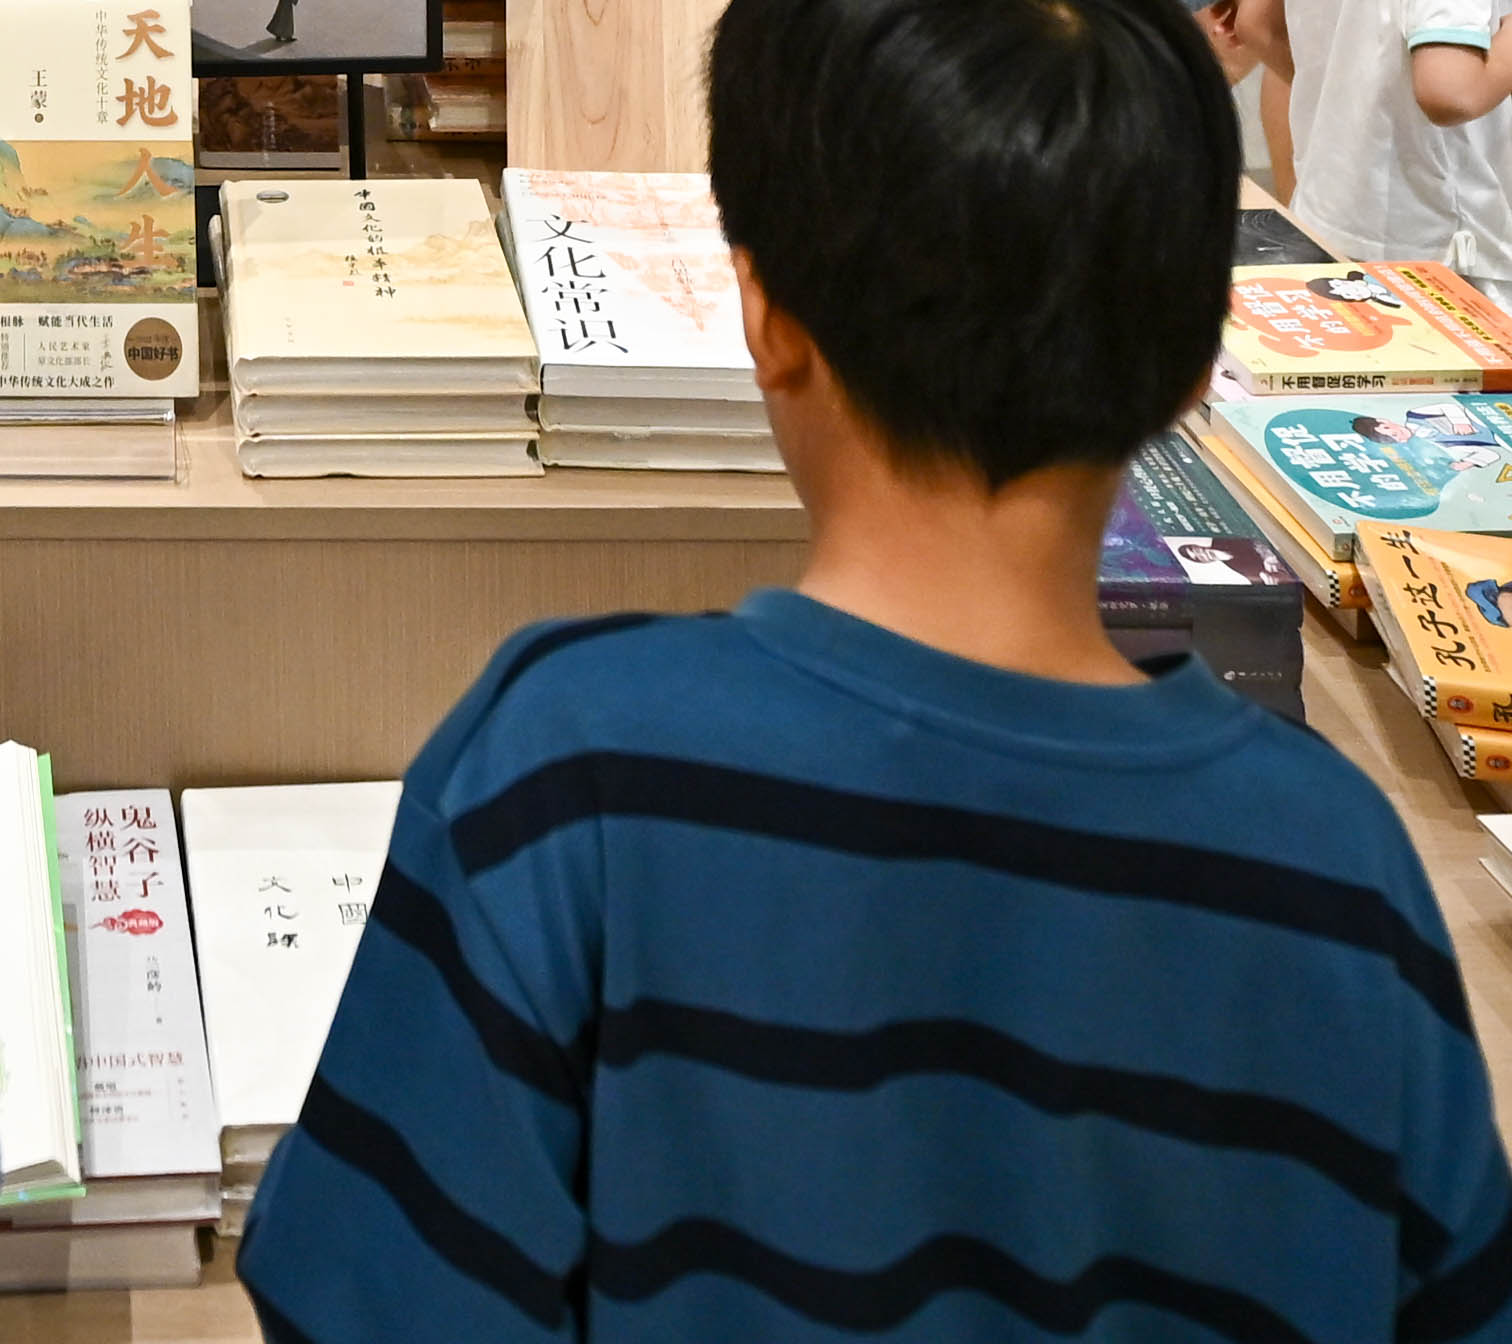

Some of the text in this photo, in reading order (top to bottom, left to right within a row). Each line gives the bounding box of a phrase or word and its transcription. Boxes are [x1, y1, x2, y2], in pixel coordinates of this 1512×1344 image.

[29, 68, 49, 110] 王蒙
[95, 9, 109, 124] 中华传统文化十章
[115, 8, 179, 268] 天地人生
[37, 315, 114, 328] 赋能当代生活
[526, 214, 629, 353] 文化常识
[1234, 282, 1326, 349] 不用督促
[1276, 288, 1352, 334] 的学习
[127, 346, 179, 362] 中国好书
[1281, 374, 1387, 390] 不用督促的学习
[1270, 423, 1377, 508] 不用督促
[1318, 432, 1409, 491] 的学习
[1380, 529, 1476, 671] 孔子这一生
[83, 807, 121, 902] 纵横智慧
[120, 804, 165, 899] 鬼谷子
